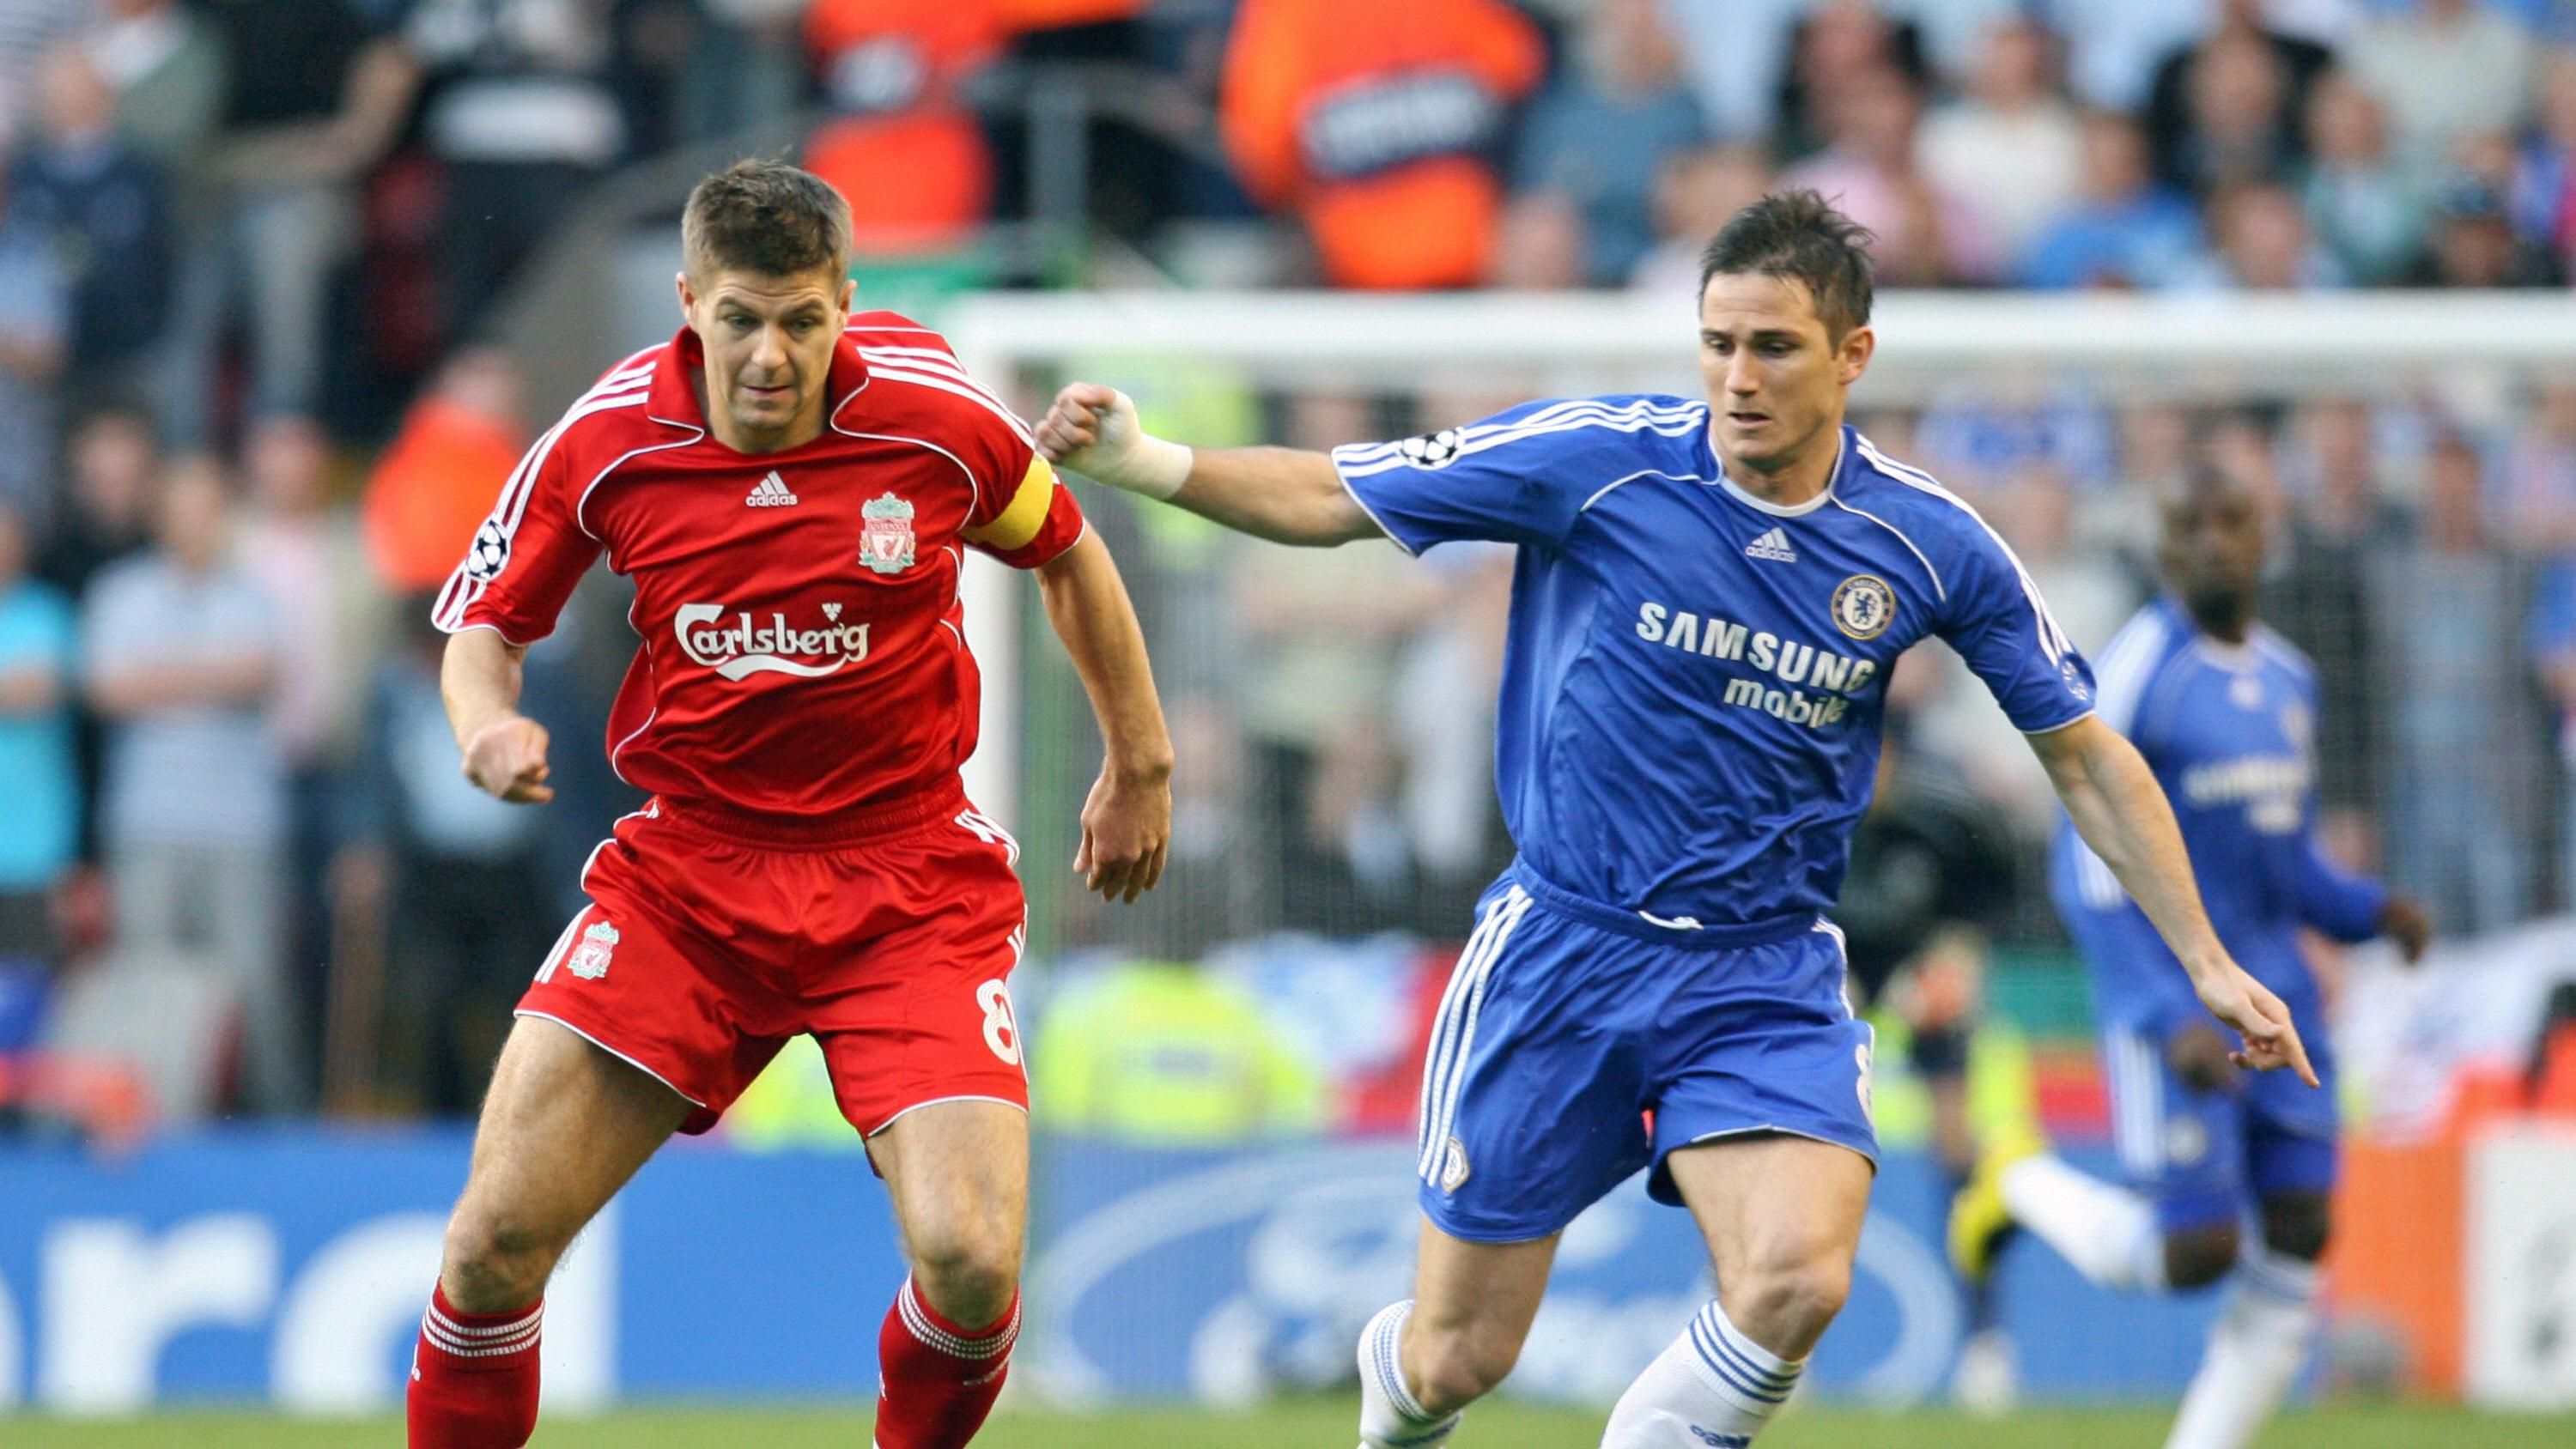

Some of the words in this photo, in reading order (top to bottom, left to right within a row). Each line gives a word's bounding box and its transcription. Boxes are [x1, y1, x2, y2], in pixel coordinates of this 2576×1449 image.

[745, 493, 799, 507] adidas
[1745, 545, 1798, 564] adidas
[674, 603, 871, 667] Carlsberg
[1636, 602, 1876, 692] SAMSUNG
